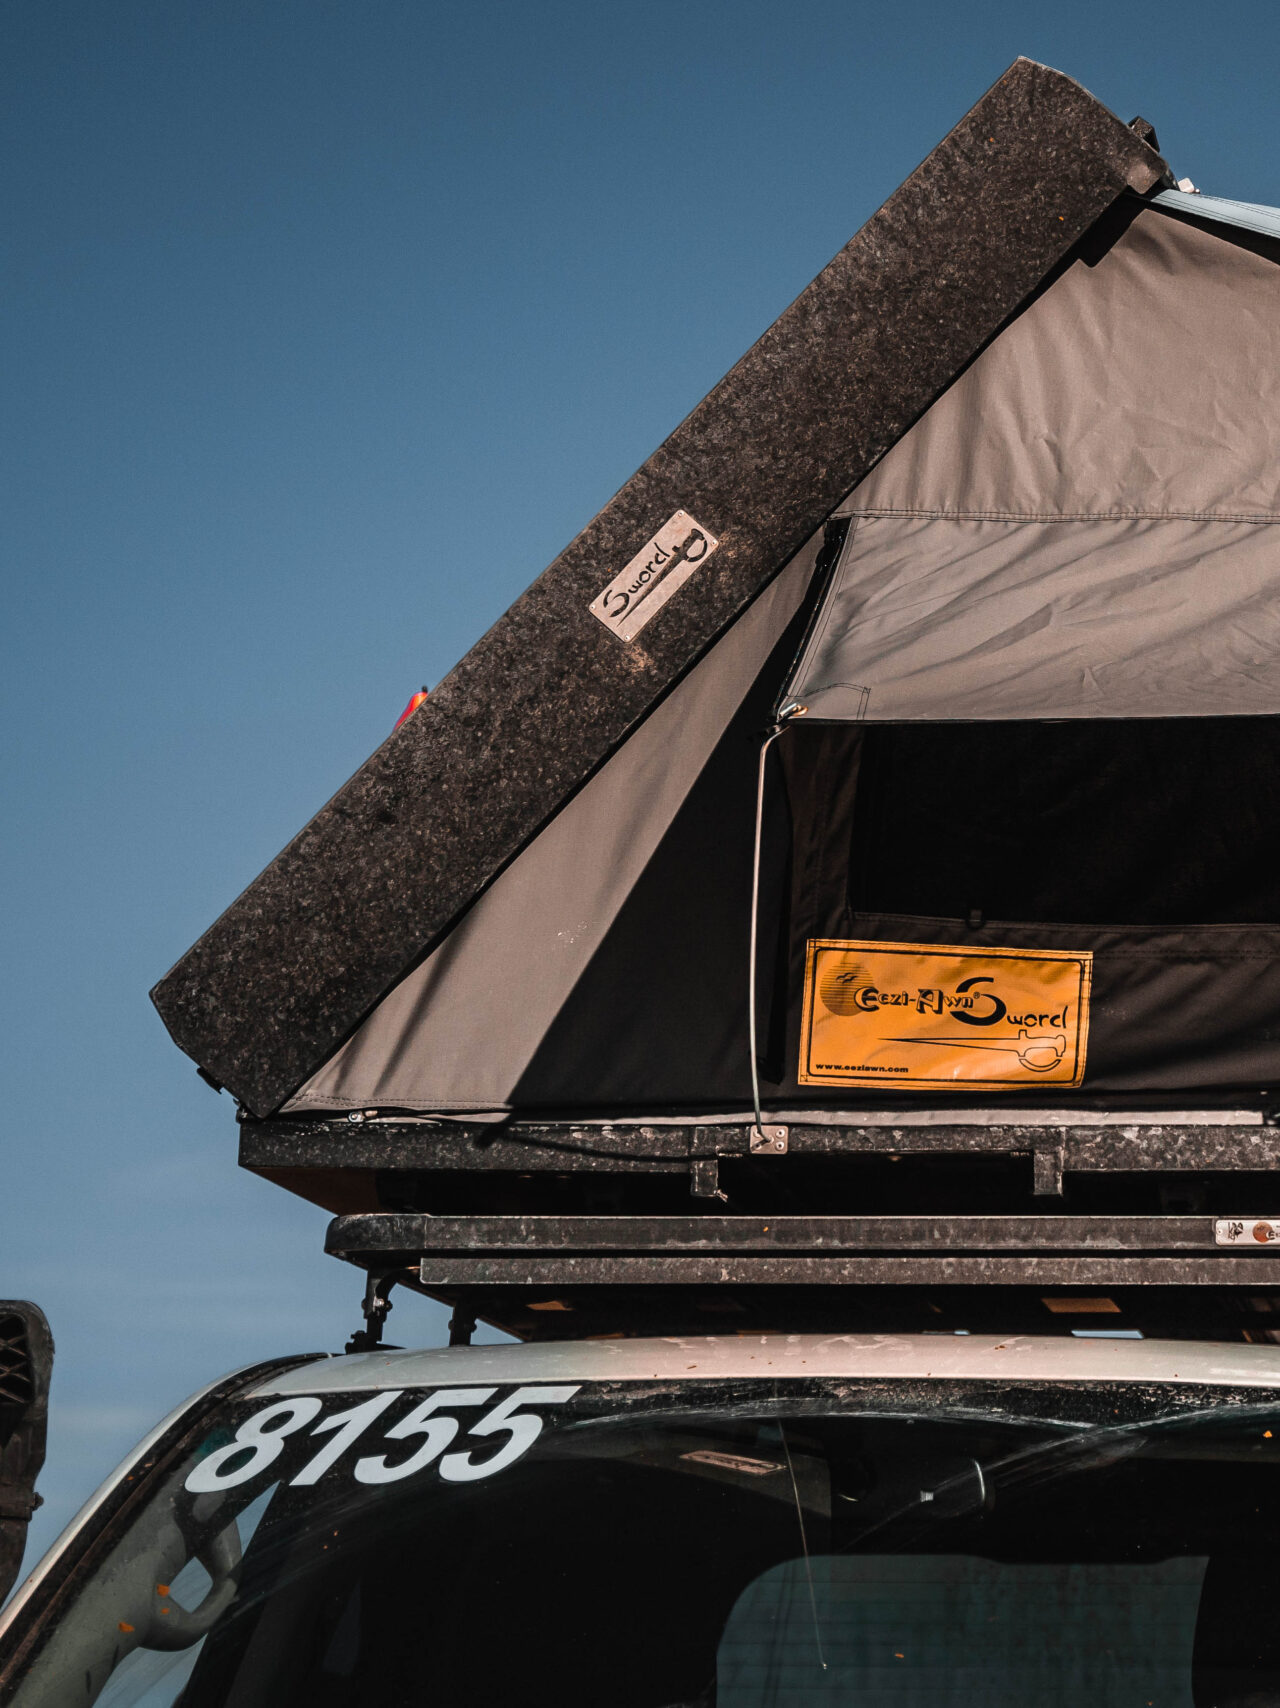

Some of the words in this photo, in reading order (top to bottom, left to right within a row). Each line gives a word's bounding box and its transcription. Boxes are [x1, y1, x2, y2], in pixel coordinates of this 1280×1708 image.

[602, 542, 671, 618] Sword
[949, 976, 1069, 1029] Sword
[815, 1063, 909, 1073] www.eeziawn.com
[184, 1385, 583, 1493] 8155
